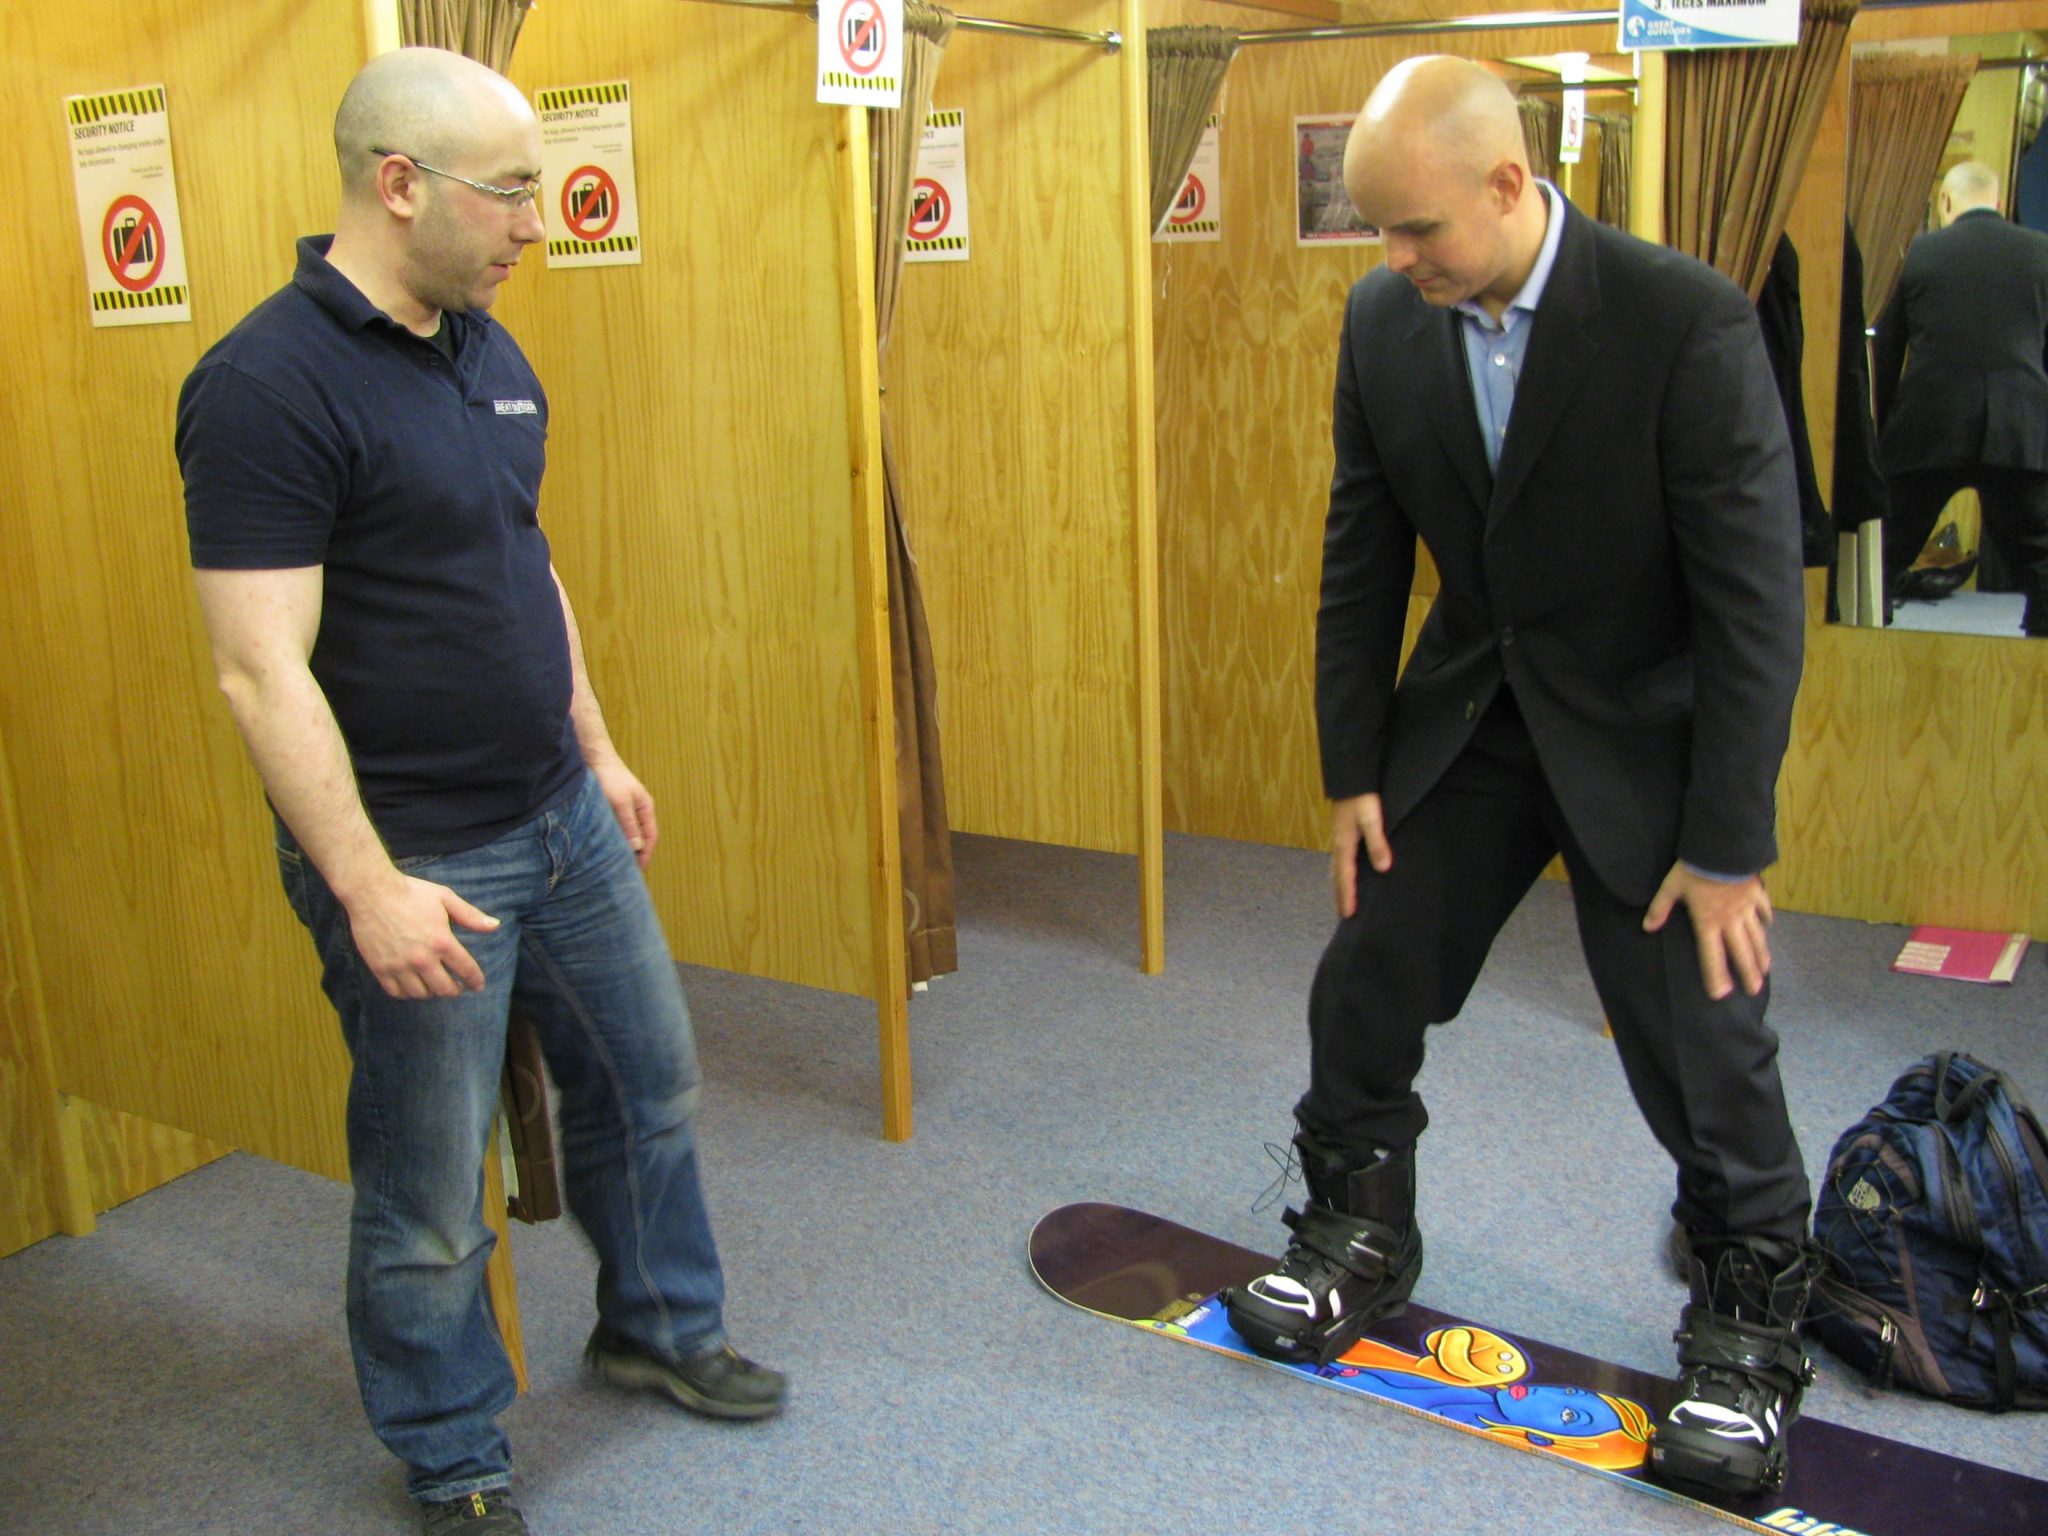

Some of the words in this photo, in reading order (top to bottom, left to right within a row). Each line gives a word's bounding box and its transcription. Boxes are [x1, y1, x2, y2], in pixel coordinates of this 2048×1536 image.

[542, 110, 573, 123] SECURITY
[575, 107, 599, 120] NOTICE
[74, 124, 107, 140] SECURITY
[108, 119, 135, 134] NOTICE
